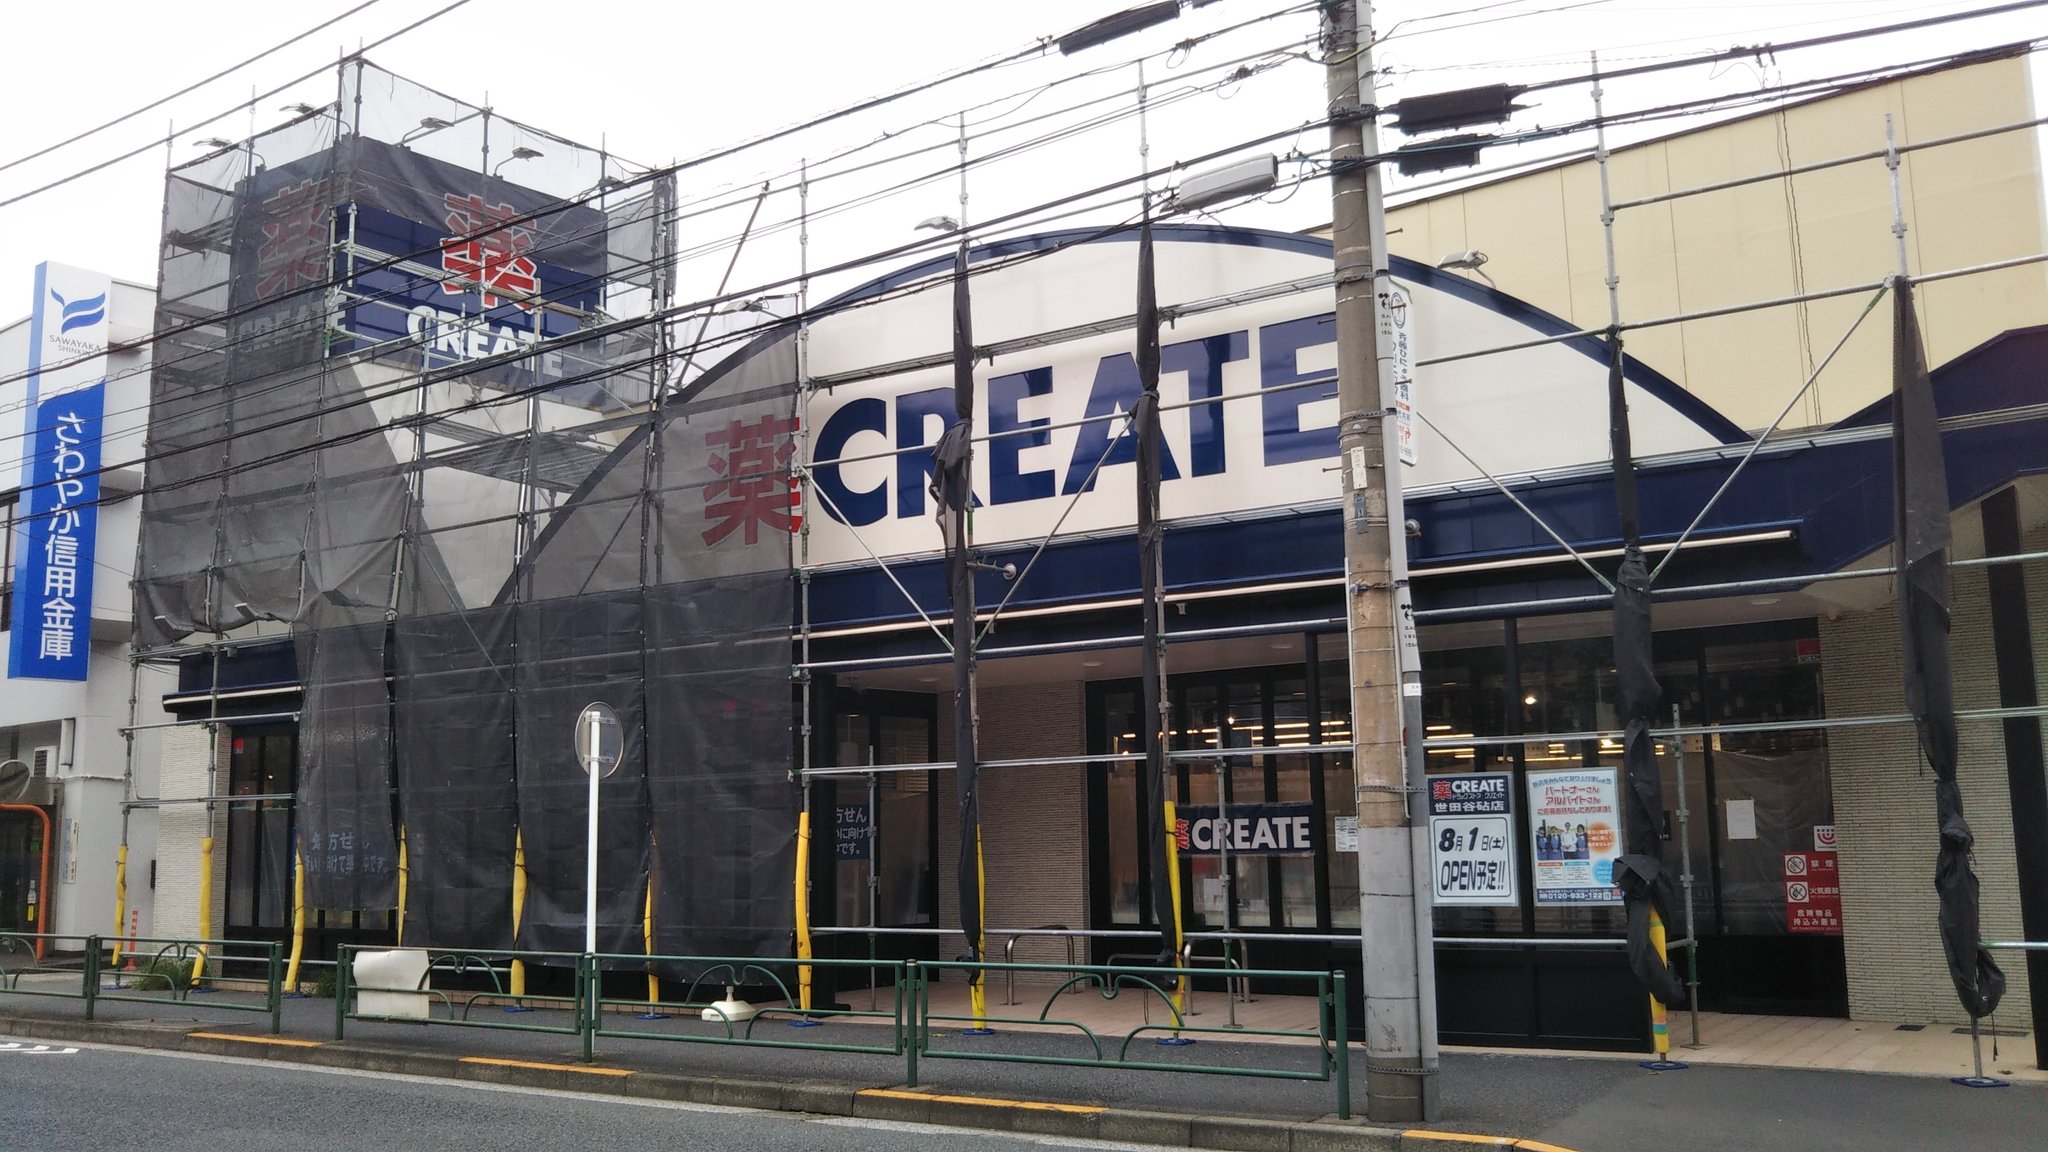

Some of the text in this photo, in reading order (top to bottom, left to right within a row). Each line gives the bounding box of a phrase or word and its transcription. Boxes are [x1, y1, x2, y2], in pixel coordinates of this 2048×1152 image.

[440, 192, 537, 315] 薬
[49, 335, 101, 353] SAWAYAKA
[407, 305, 564, 377] CREATE
[812, 313, 1343, 526] CREATE
[701, 413, 802, 548] 薬
[39, 412, 84, 661] さわやか信用金庫
[1433, 780, 1505, 800] 薬 CREATE
[1434, 801, 1504, 813] 世田谷砧店
[1545, 785, 1599, 796] パートナーさん
[1545, 796, 1600, 806] アルバイトさん
[1191, 816, 1311, 850] CREATE
